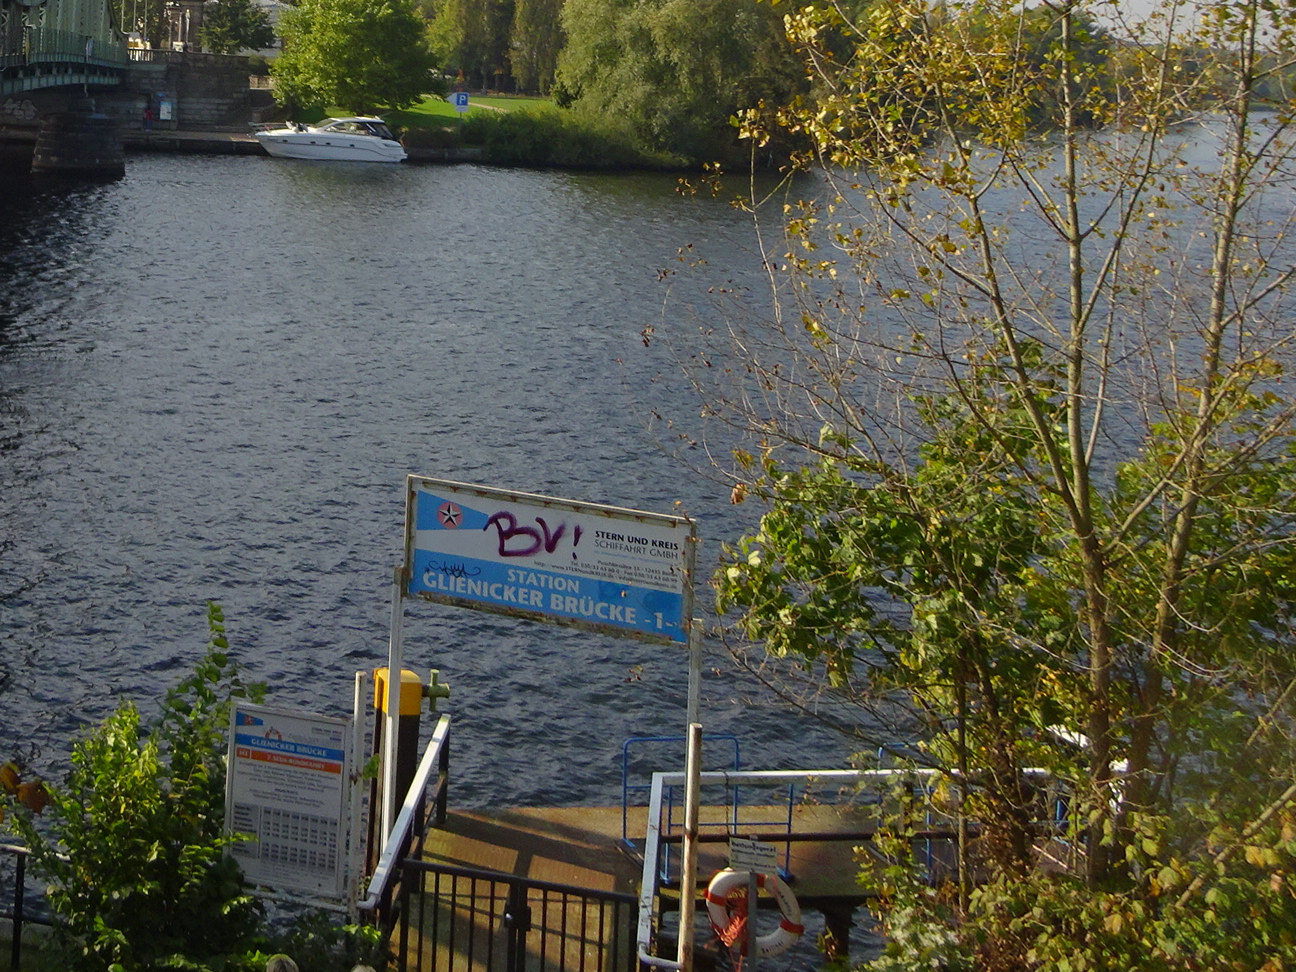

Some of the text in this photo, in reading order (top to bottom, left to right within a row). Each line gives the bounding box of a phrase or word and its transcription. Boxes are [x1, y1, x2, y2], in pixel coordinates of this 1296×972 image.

[594, 539, 646, 556] SCHIFFAHRT
[649, 547, 678, 560] GMBH
[595, 530, 679, 551] STERN UND KREIS
[507, 569, 580, 594] STATION
[422, 571, 543, 608] GLIENICKER
[550, 593, 637, 625] BRÜCKE
